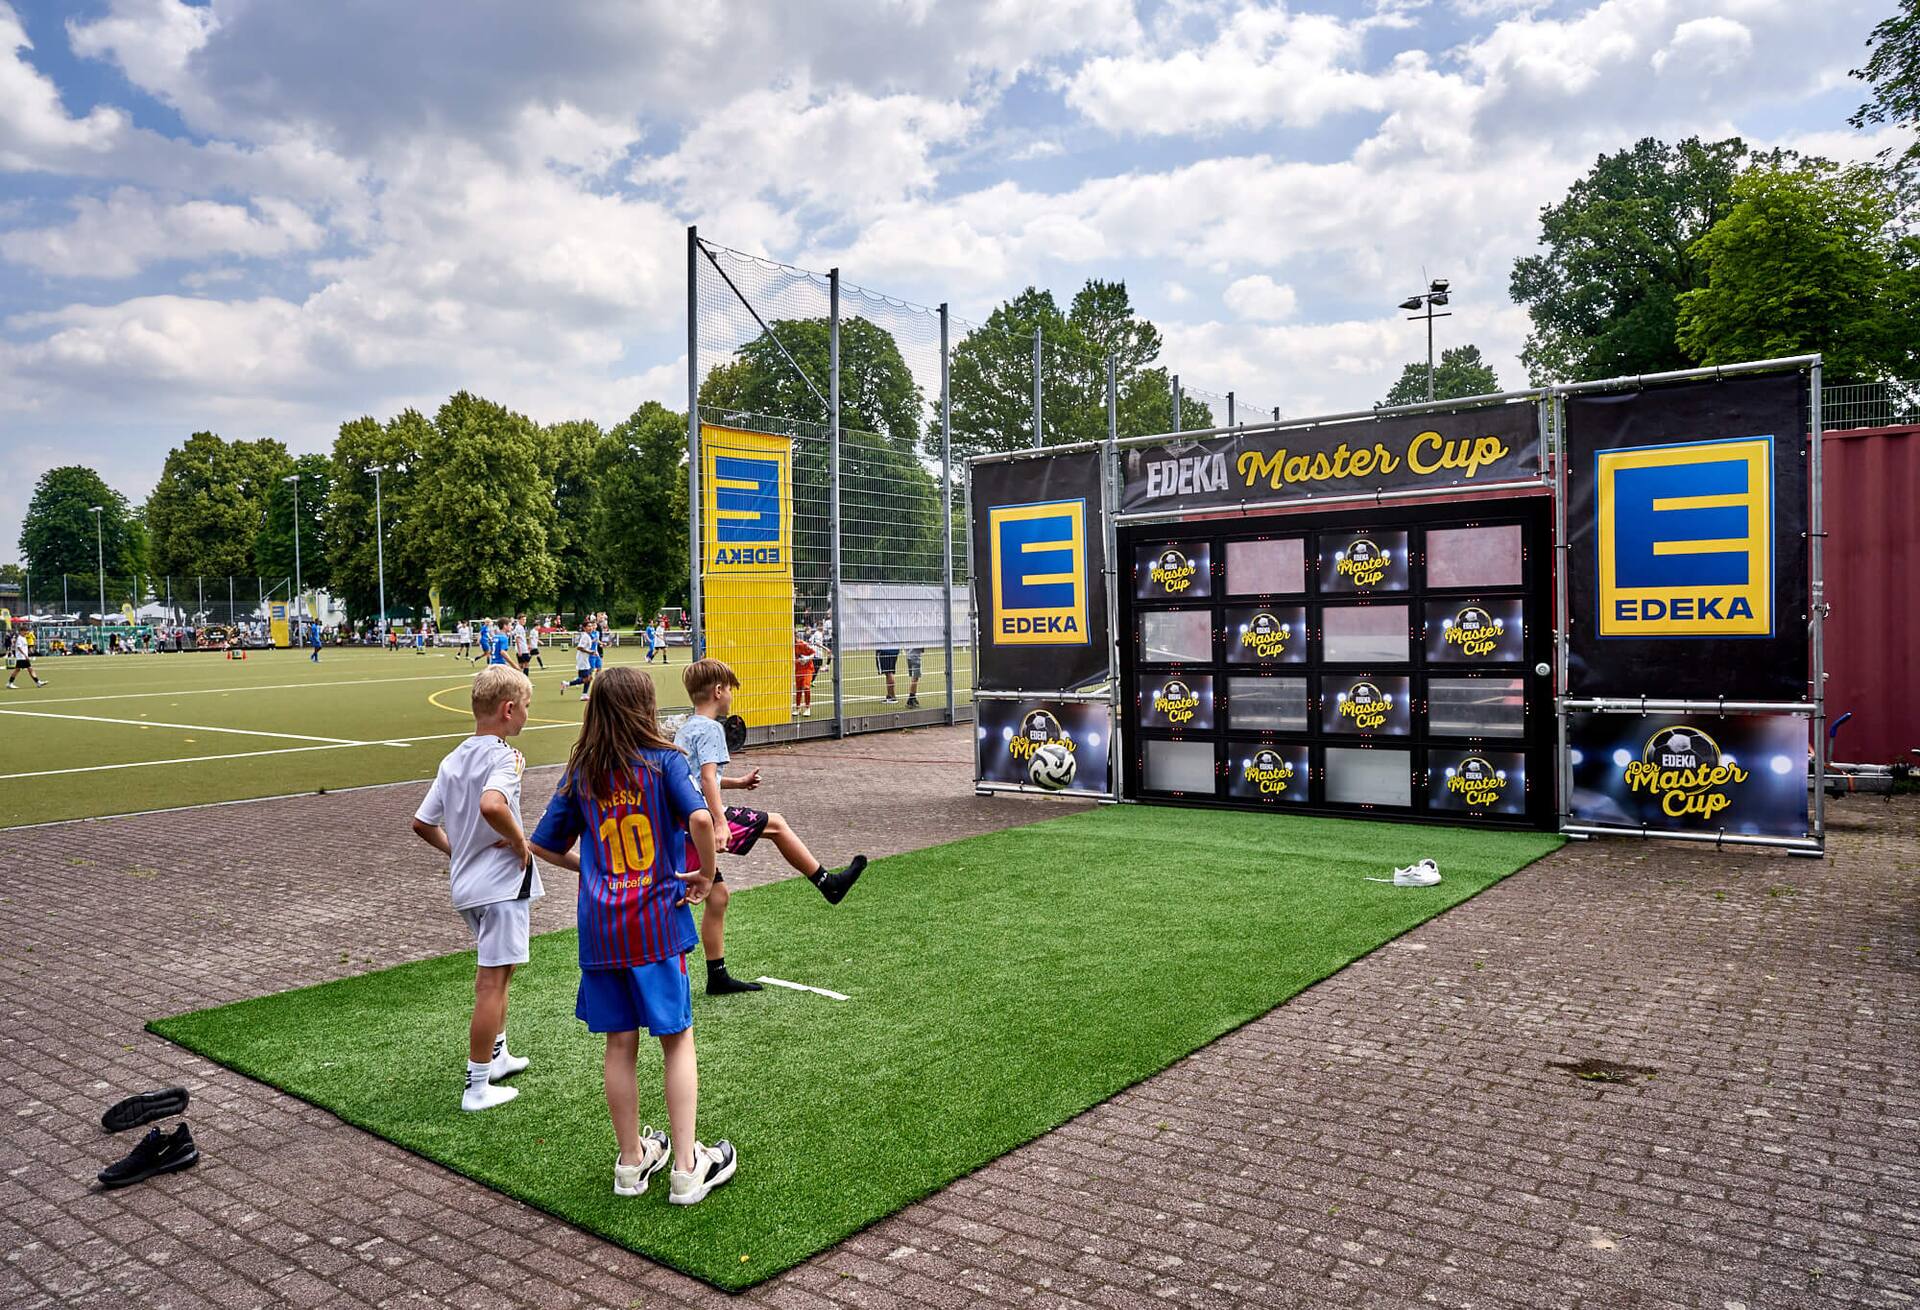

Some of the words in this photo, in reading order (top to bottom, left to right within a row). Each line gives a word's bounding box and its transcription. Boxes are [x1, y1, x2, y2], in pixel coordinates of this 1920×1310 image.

[1146, 453, 1229, 498] EDEKA
[1238, 449, 1400, 489] Master
[1408, 431, 1508, 478] Cup
[1337, 557, 1391, 575] Master
[1151, 566, 1196, 583] Master
[1354, 571, 1384, 586] Cup
[1165, 579, 1191, 592] Cup
[1615, 597, 1754, 621] EDEKA
[1002, 616, 1078, 634] EDEKA
[1241, 630, 1291, 647] Master
[1445, 624, 1504, 644] Master
[1257, 643, 1285, 657] Cup
[1463, 641, 1497, 656] Cup
[1154, 697, 1200, 712] Master
[1339, 701, 1393, 717] Master
[1169, 710, 1194, 723] Cup
[1356, 714, 1386, 728] Cup
[1628, 761, 1661, 775] Der
[1662, 754, 1696, 768] EDEKA
[1245, 768, 1294, 782] Master
[1625, 763, 1748, 794] Master
[1260, 780, 1288, 794] Cup
[1447, 776, 1507, 793] Master
[1466, 790, 1499, 806] Cup
[1662, 790, 1731, 819] Cup
[599, 814, 655, 874] 10
[609, 876, 641, 890] unicef
